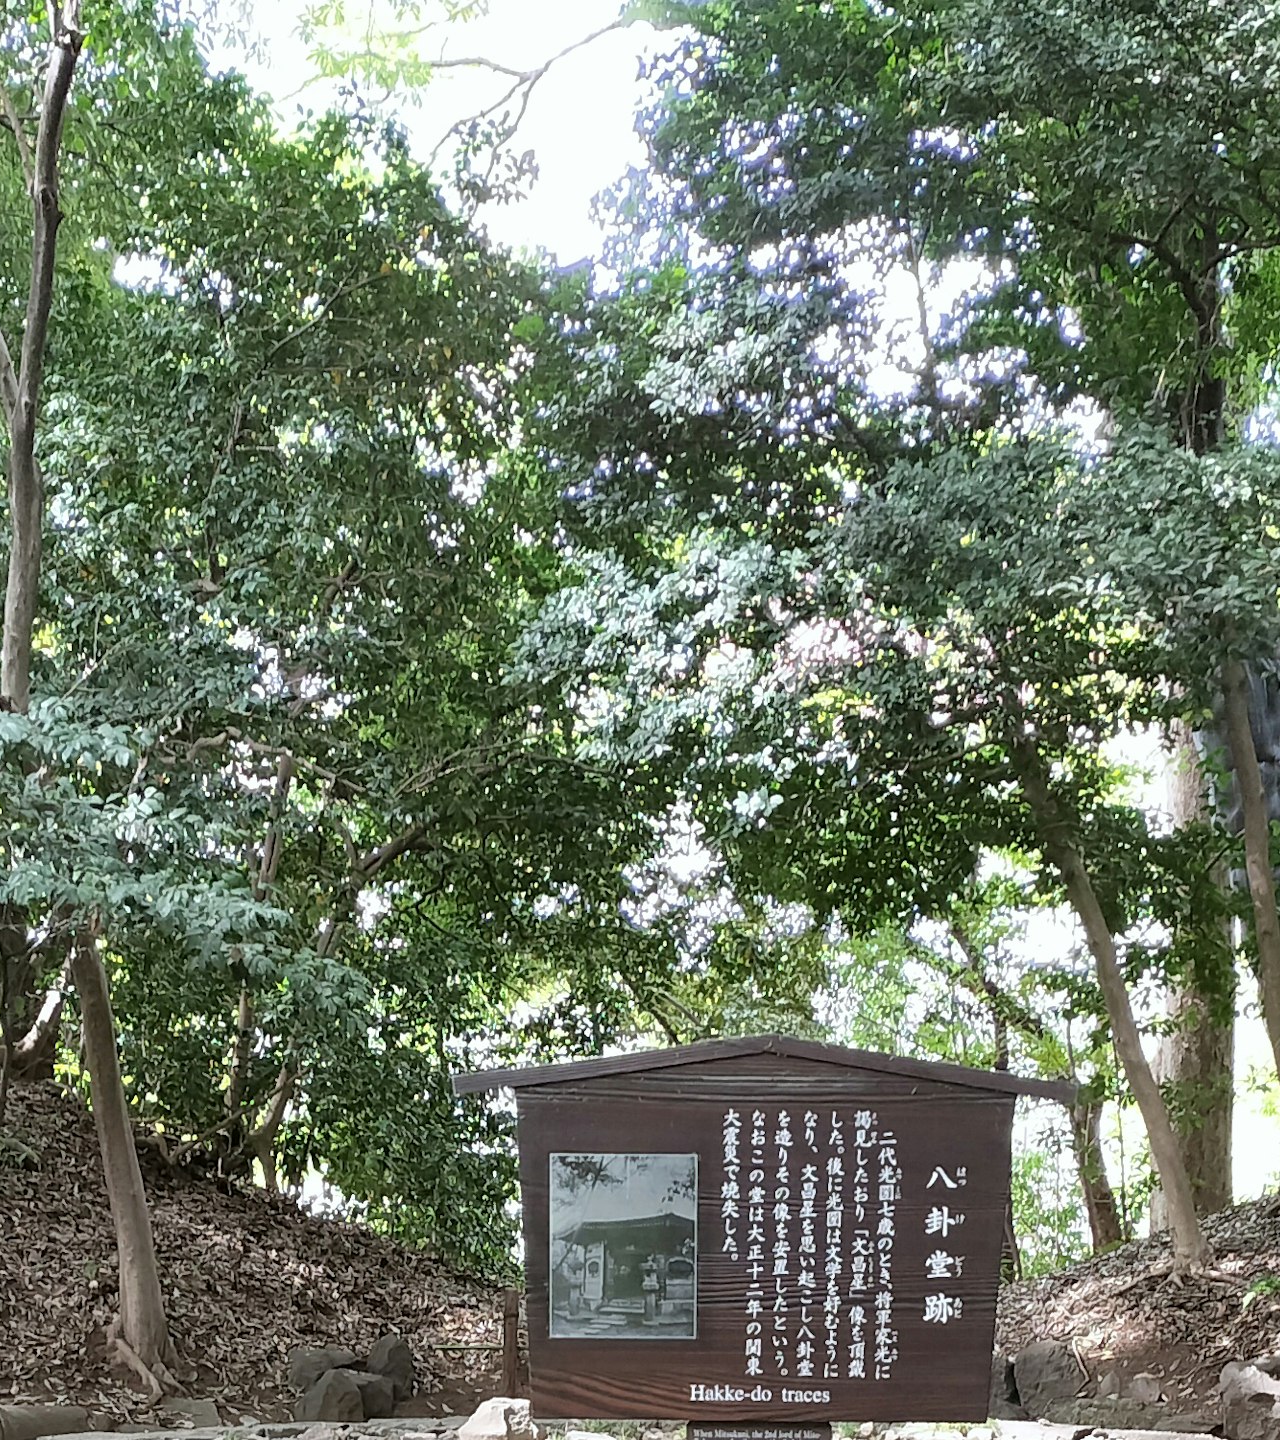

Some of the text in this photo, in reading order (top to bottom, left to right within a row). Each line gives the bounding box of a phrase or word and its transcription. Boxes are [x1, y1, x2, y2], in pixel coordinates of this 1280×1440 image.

[721, 1108, 742, 1262] 大震災で焼失した。
[745, 1109, 766, 1377] なおこの堂は大正十二年の関東
[772, 1110, 794, 1377] を造りその像を安置したという。
[922, 1166, 957, 1324] 八卦堂跡
[690, 1384, 830, 1403] Hakke-do traces
